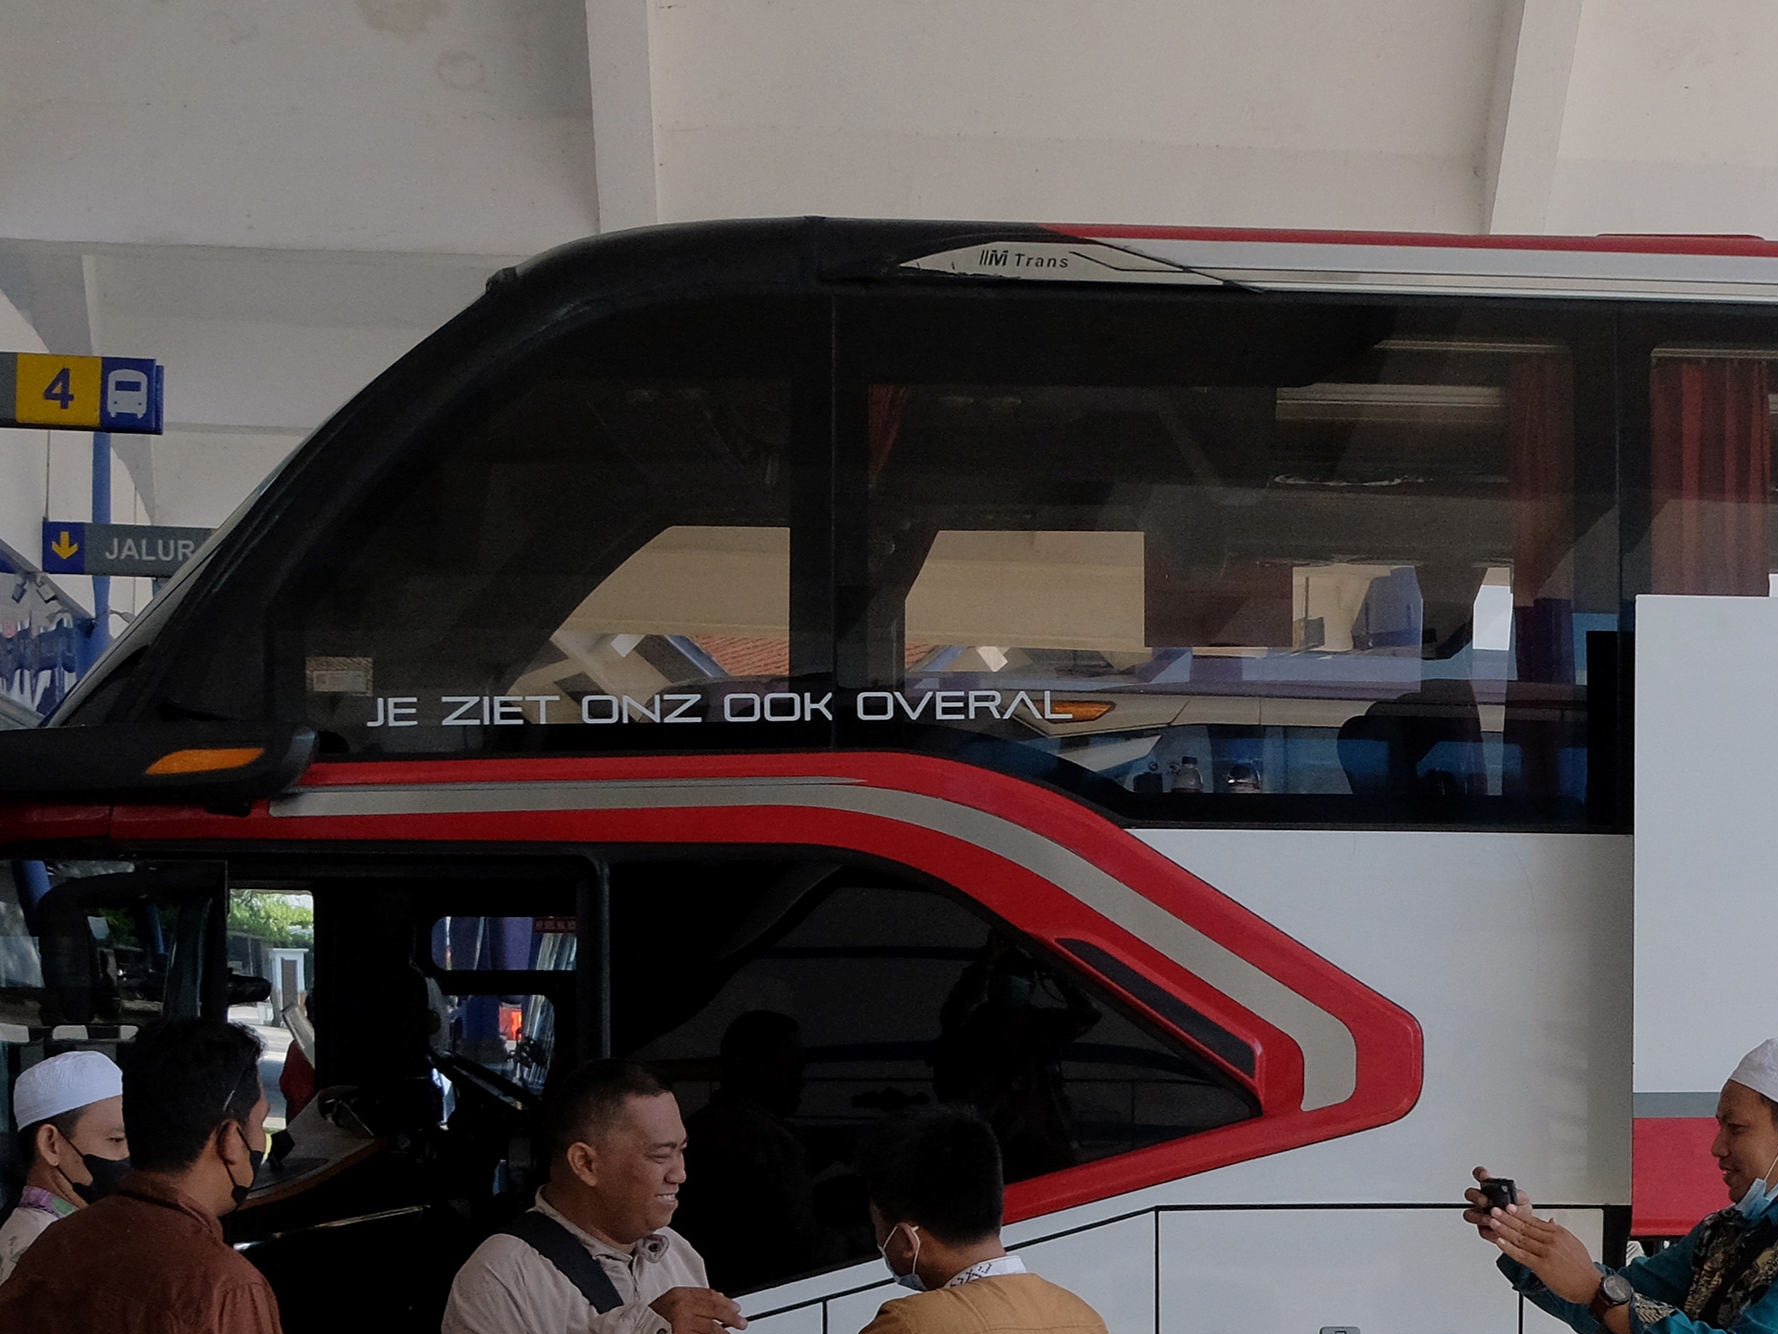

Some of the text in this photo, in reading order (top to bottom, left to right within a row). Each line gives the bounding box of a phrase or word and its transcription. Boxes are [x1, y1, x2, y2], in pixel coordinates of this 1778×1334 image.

[1014, 252, 1069, 269] Trans
[43, 367, 75, 410] 4
[105, 537, 197, 562] JALUR
[366, 690, 1074, 727] JE ZIET ONZ OOK OVERAL
